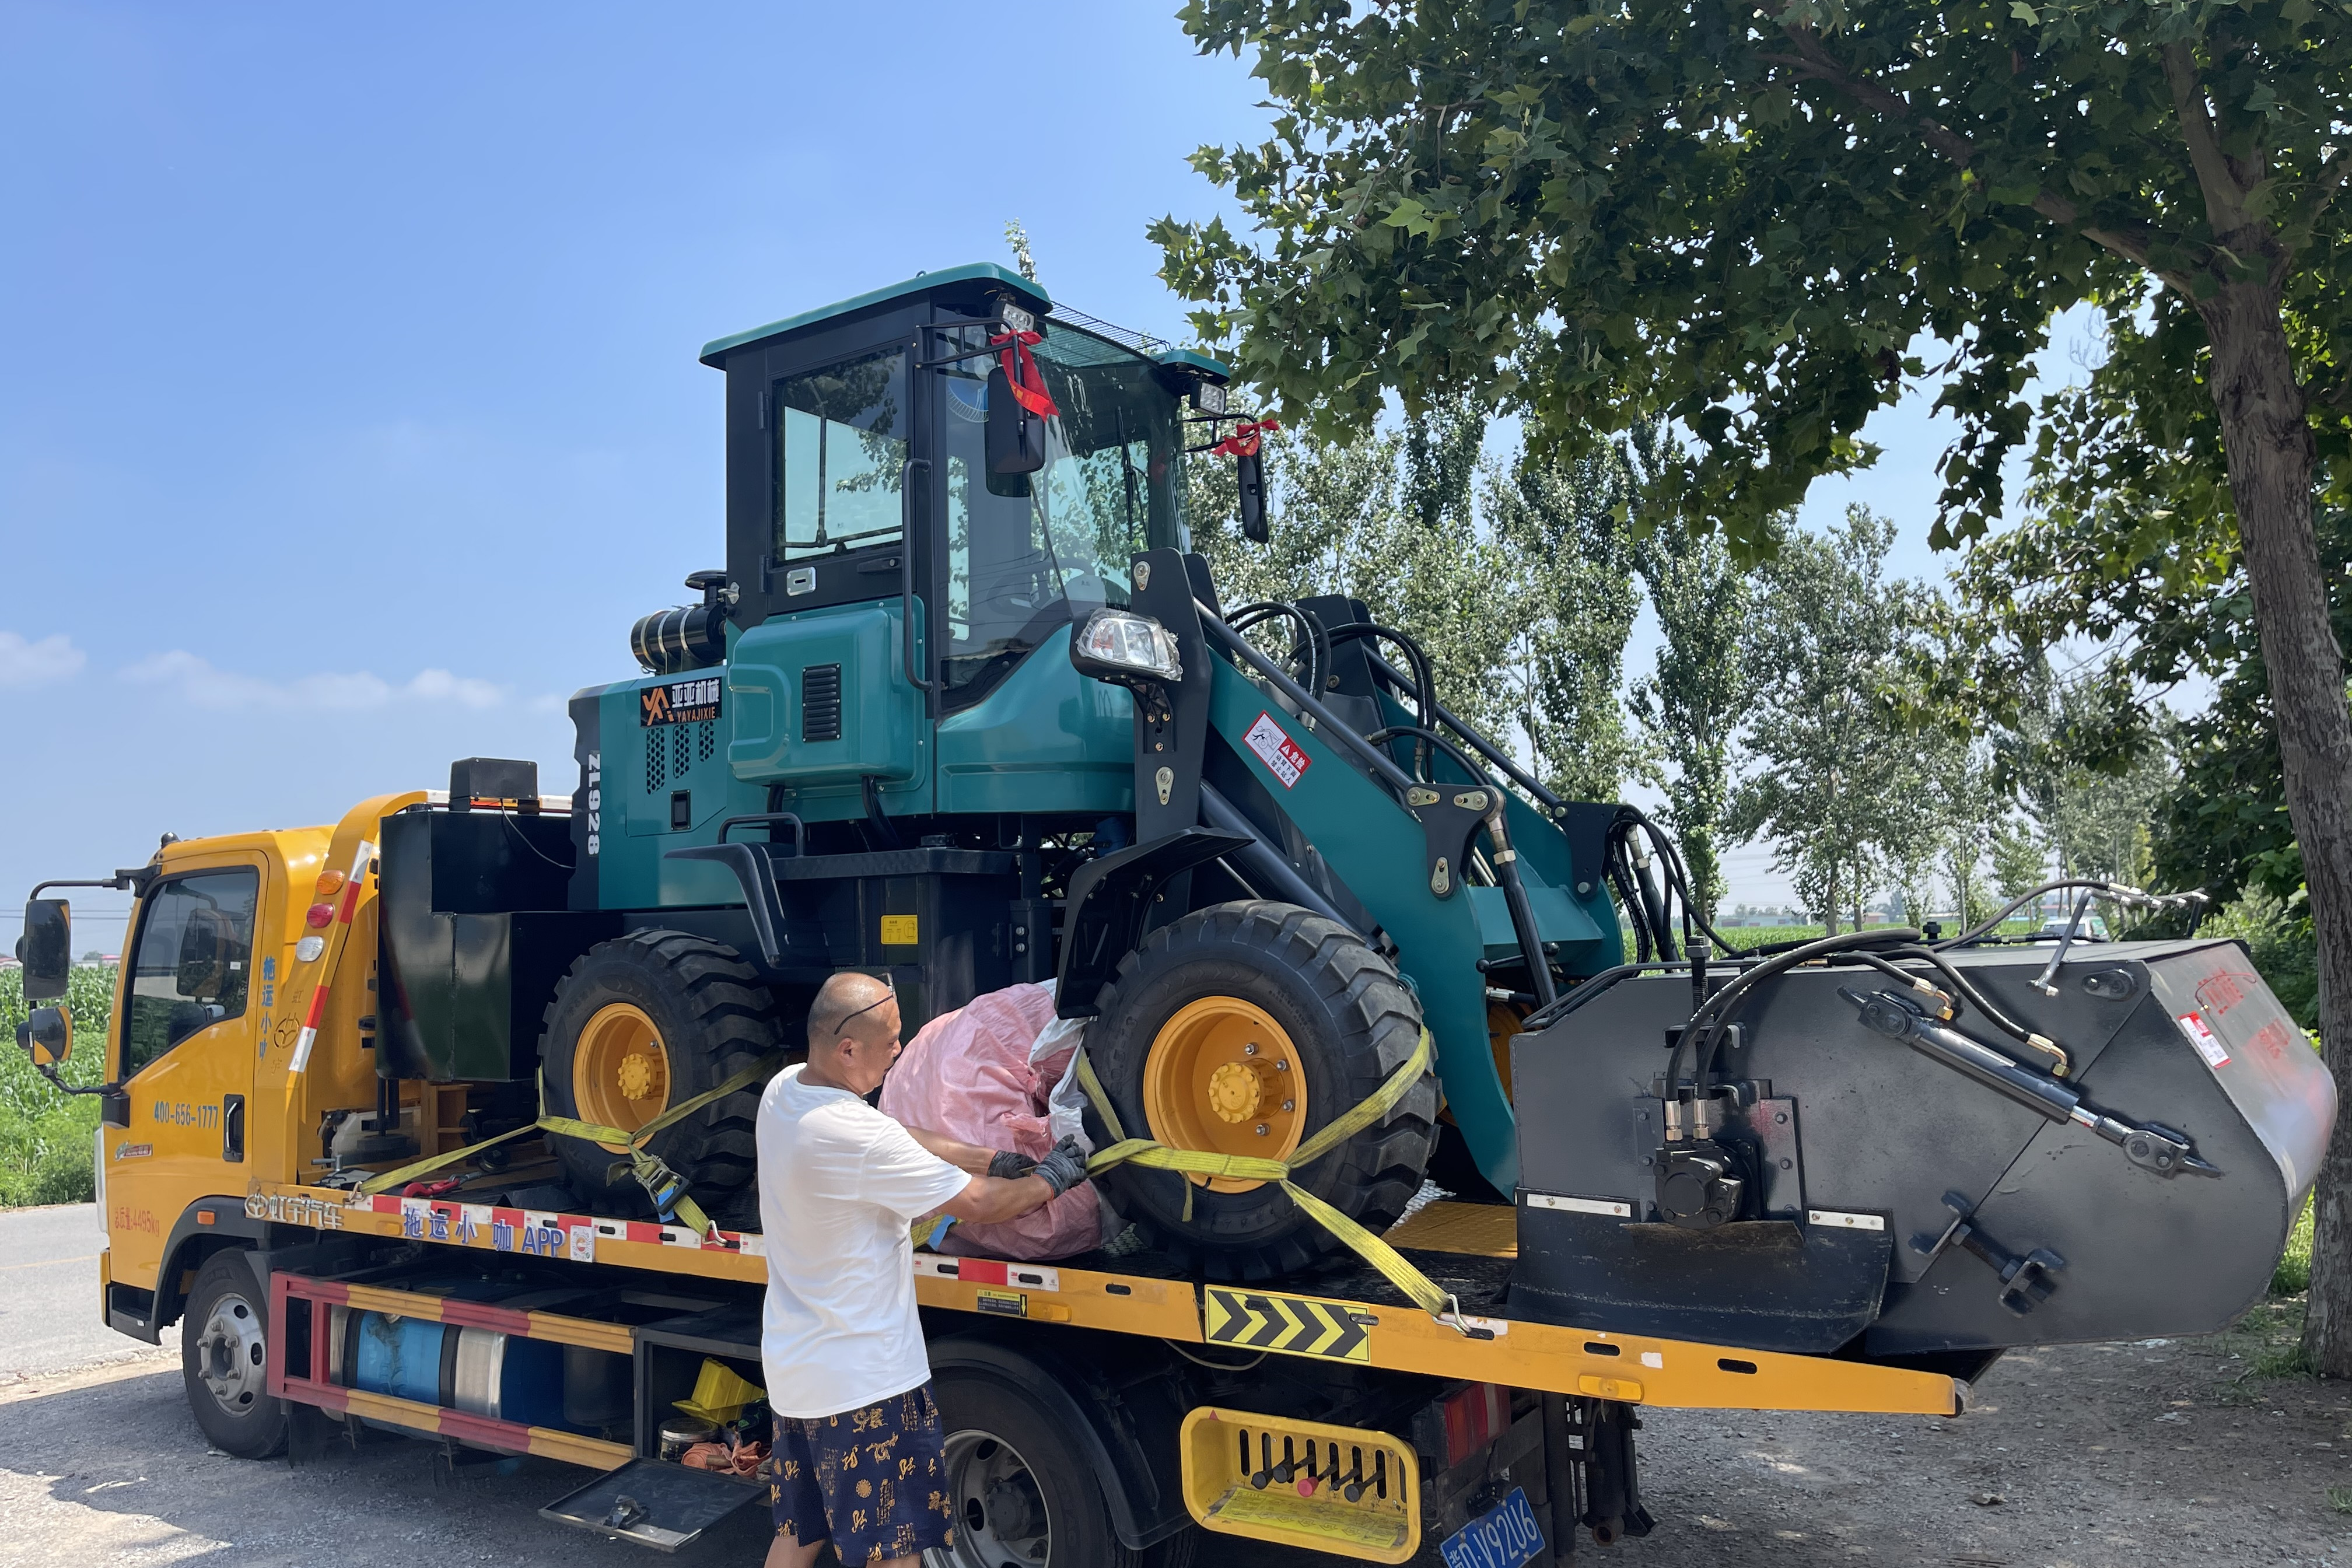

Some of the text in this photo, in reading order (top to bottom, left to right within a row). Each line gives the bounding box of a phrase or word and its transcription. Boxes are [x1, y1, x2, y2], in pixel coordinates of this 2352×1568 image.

[672, 678, 719, 708] 亚亚机械
[677, 706, 715, 723] YAYAJIXIE
[1270, 760, 1292, 783] 禁止站人
[1289, 751, 1306, 769] 危险
[588, 754, 601, 855] ZL928
[154, 1101, 218, 1129] 400-656-1777
[270, 1195, 344, 1230] 虹宇汽车
